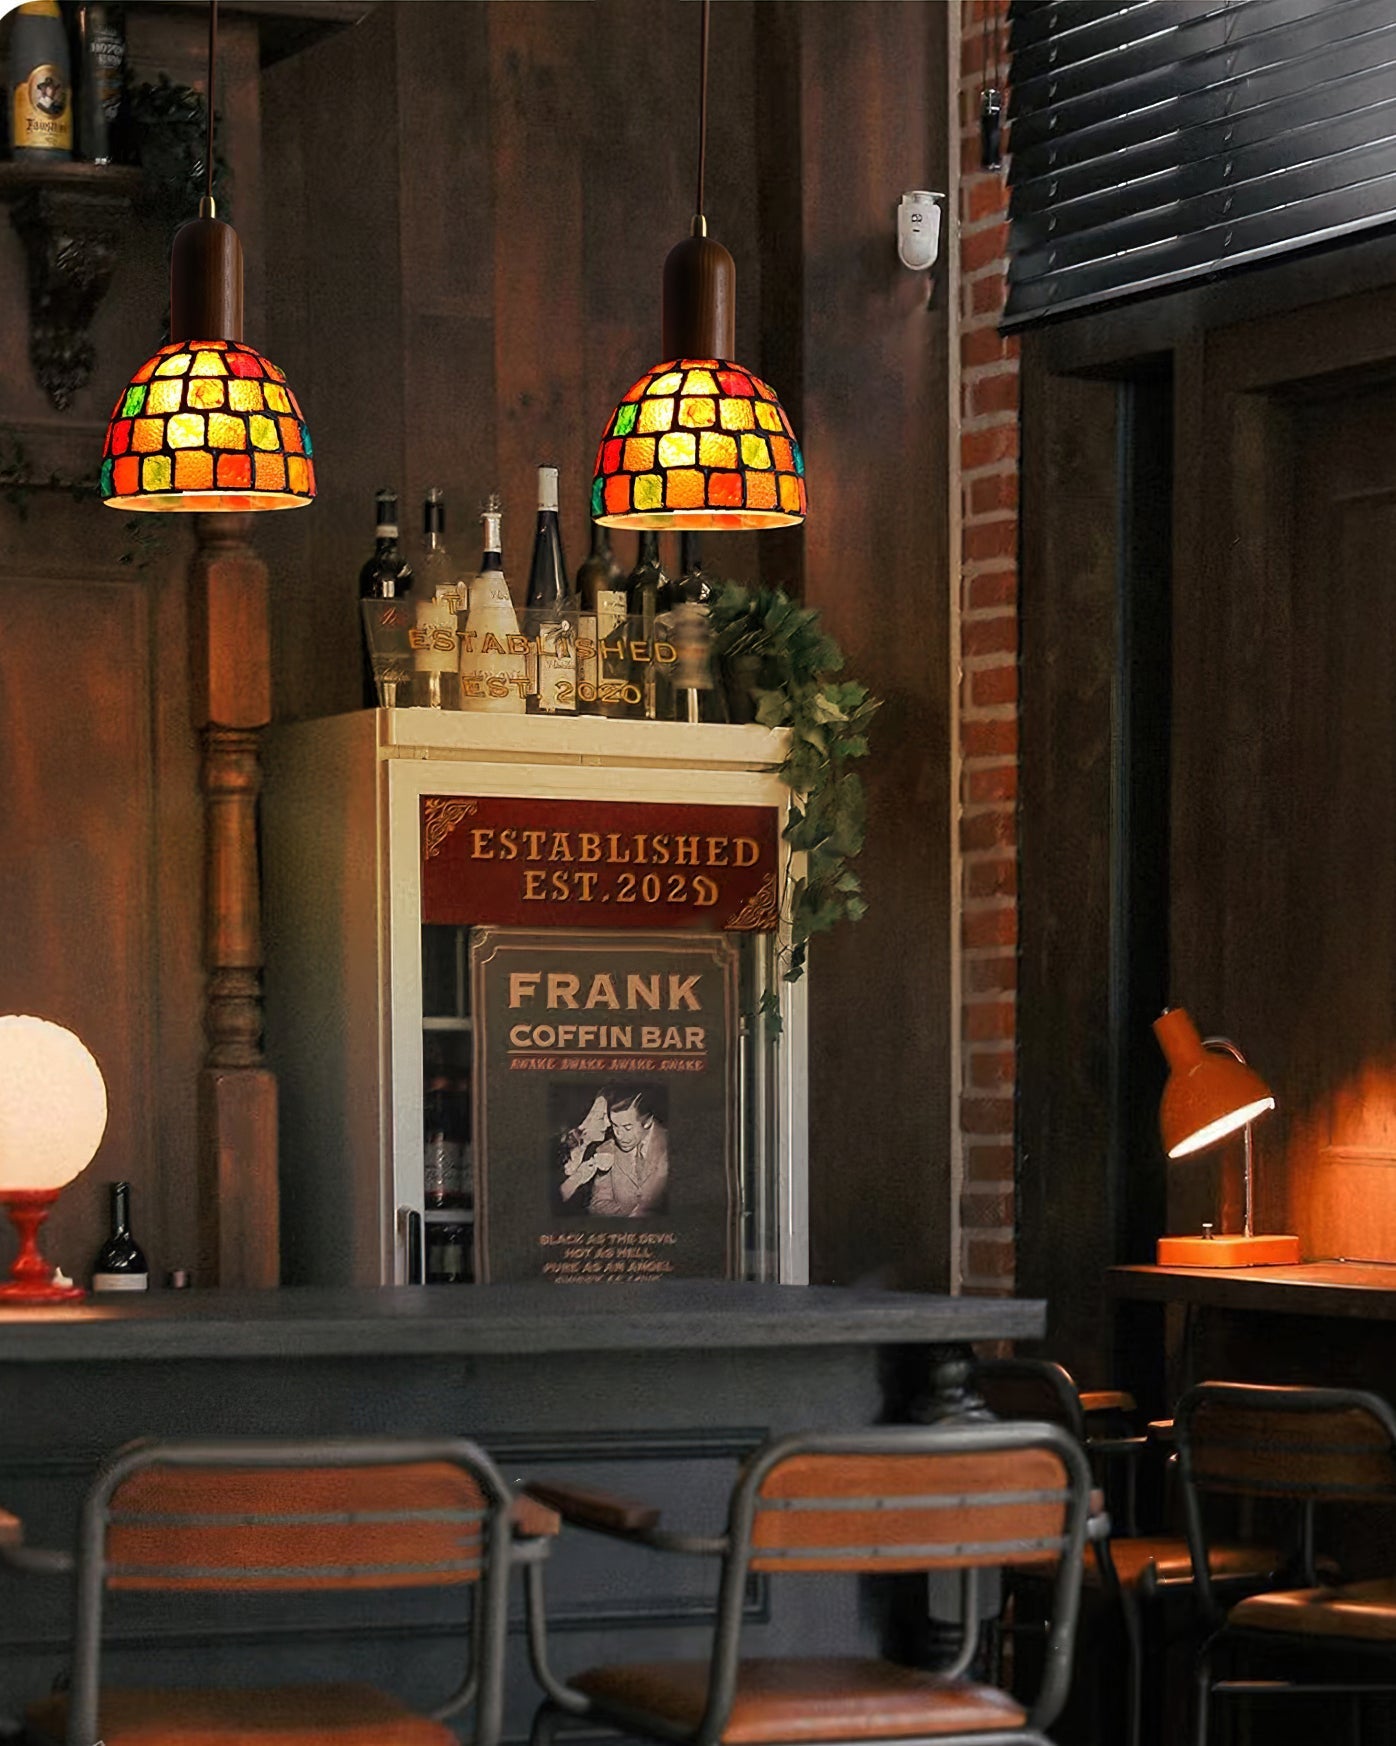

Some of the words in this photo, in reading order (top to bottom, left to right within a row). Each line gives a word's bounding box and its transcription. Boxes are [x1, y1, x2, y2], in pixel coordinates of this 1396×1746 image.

[409, 628, 677, 663] ESTABLISHED
[554, 679, 642, 704] 2020
[470, 828, 760, 867] ESTABLISHED
[508, 972, 703, 1010] FRANK
[509, 1023, 633, 1049] COFFIN
[640, 1026, 705, 1050] BAR
[616, 1247, 655, 1259] HELL
